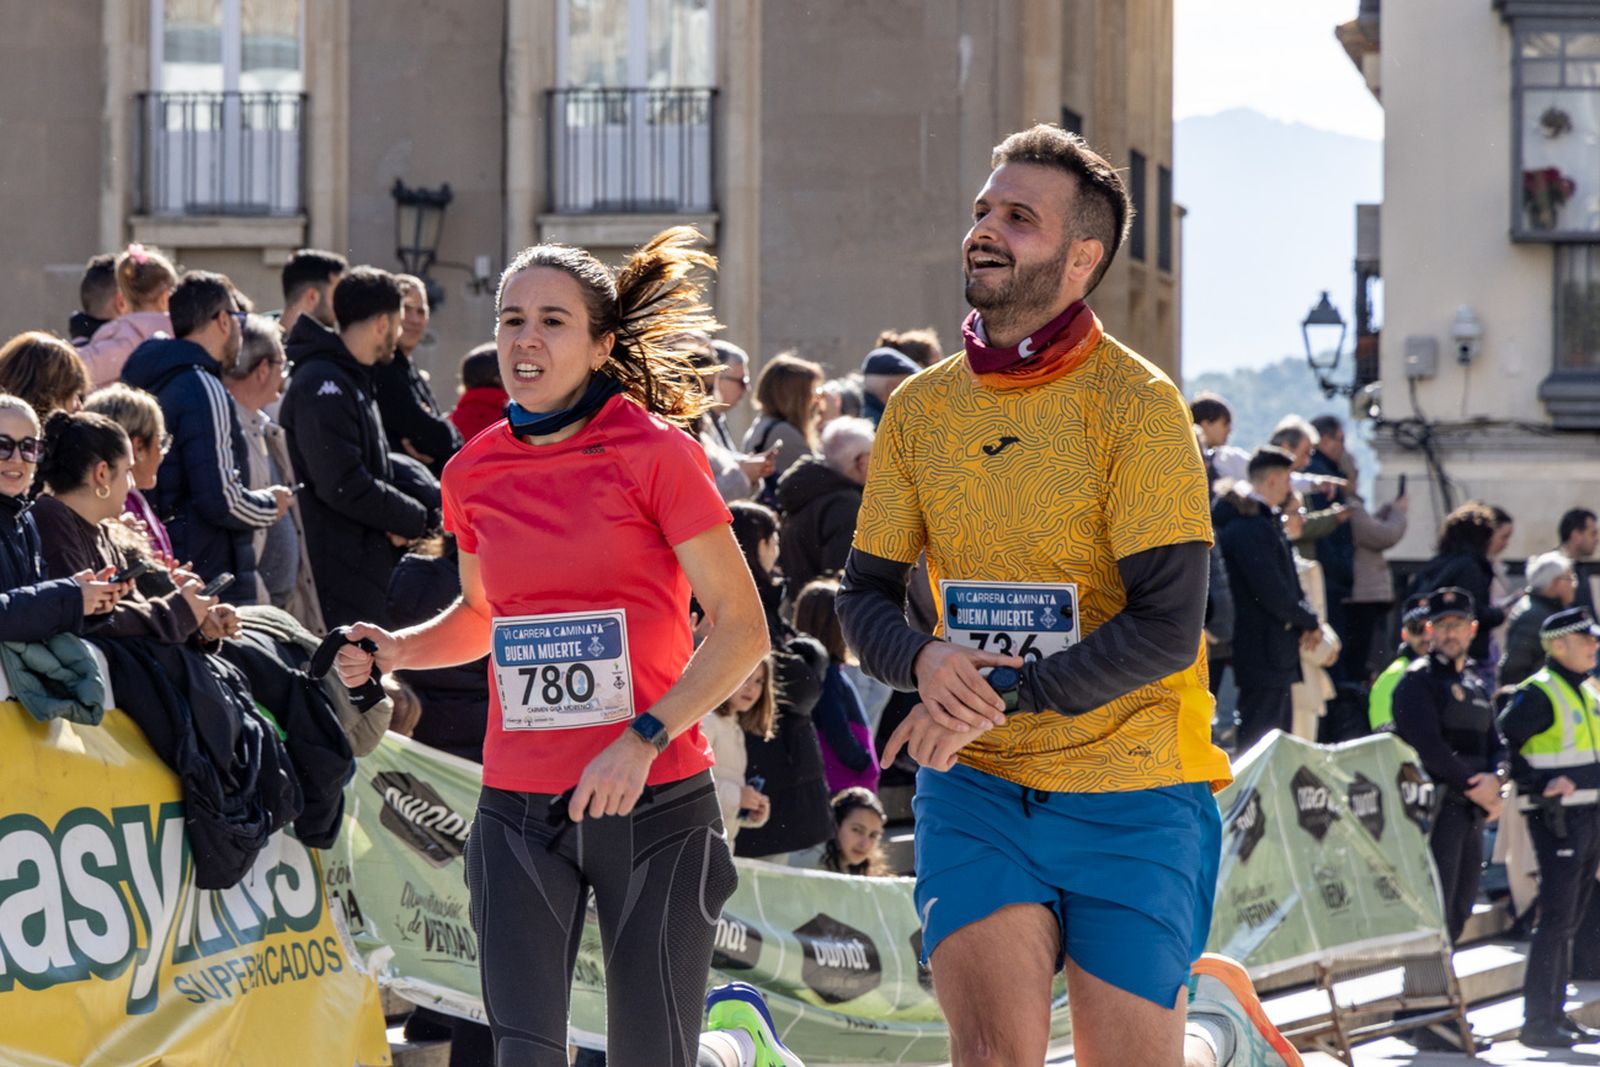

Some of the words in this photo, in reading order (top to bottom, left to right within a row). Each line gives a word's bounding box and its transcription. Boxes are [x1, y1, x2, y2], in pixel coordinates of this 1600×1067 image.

[956, 592, 965, 602] VI
[966, 592, 1005, 604] CARRERA
[1006, 592, 1057, 605] CAMINATA
[957, 608, 988, 626] BUENA
[991, 609, 1034, 627] MUERTE
[503, 630, 511, 640] VI
[512, 627, 550, 640] CARRERA
[553, 623, 604, 637] CAMINATA
[504, 644, 536, 662] BUENA
[538, 641, 583, 660] MUERTE
[518, 662, 595, 706] 780
[714, 917, 748, 953] nat
